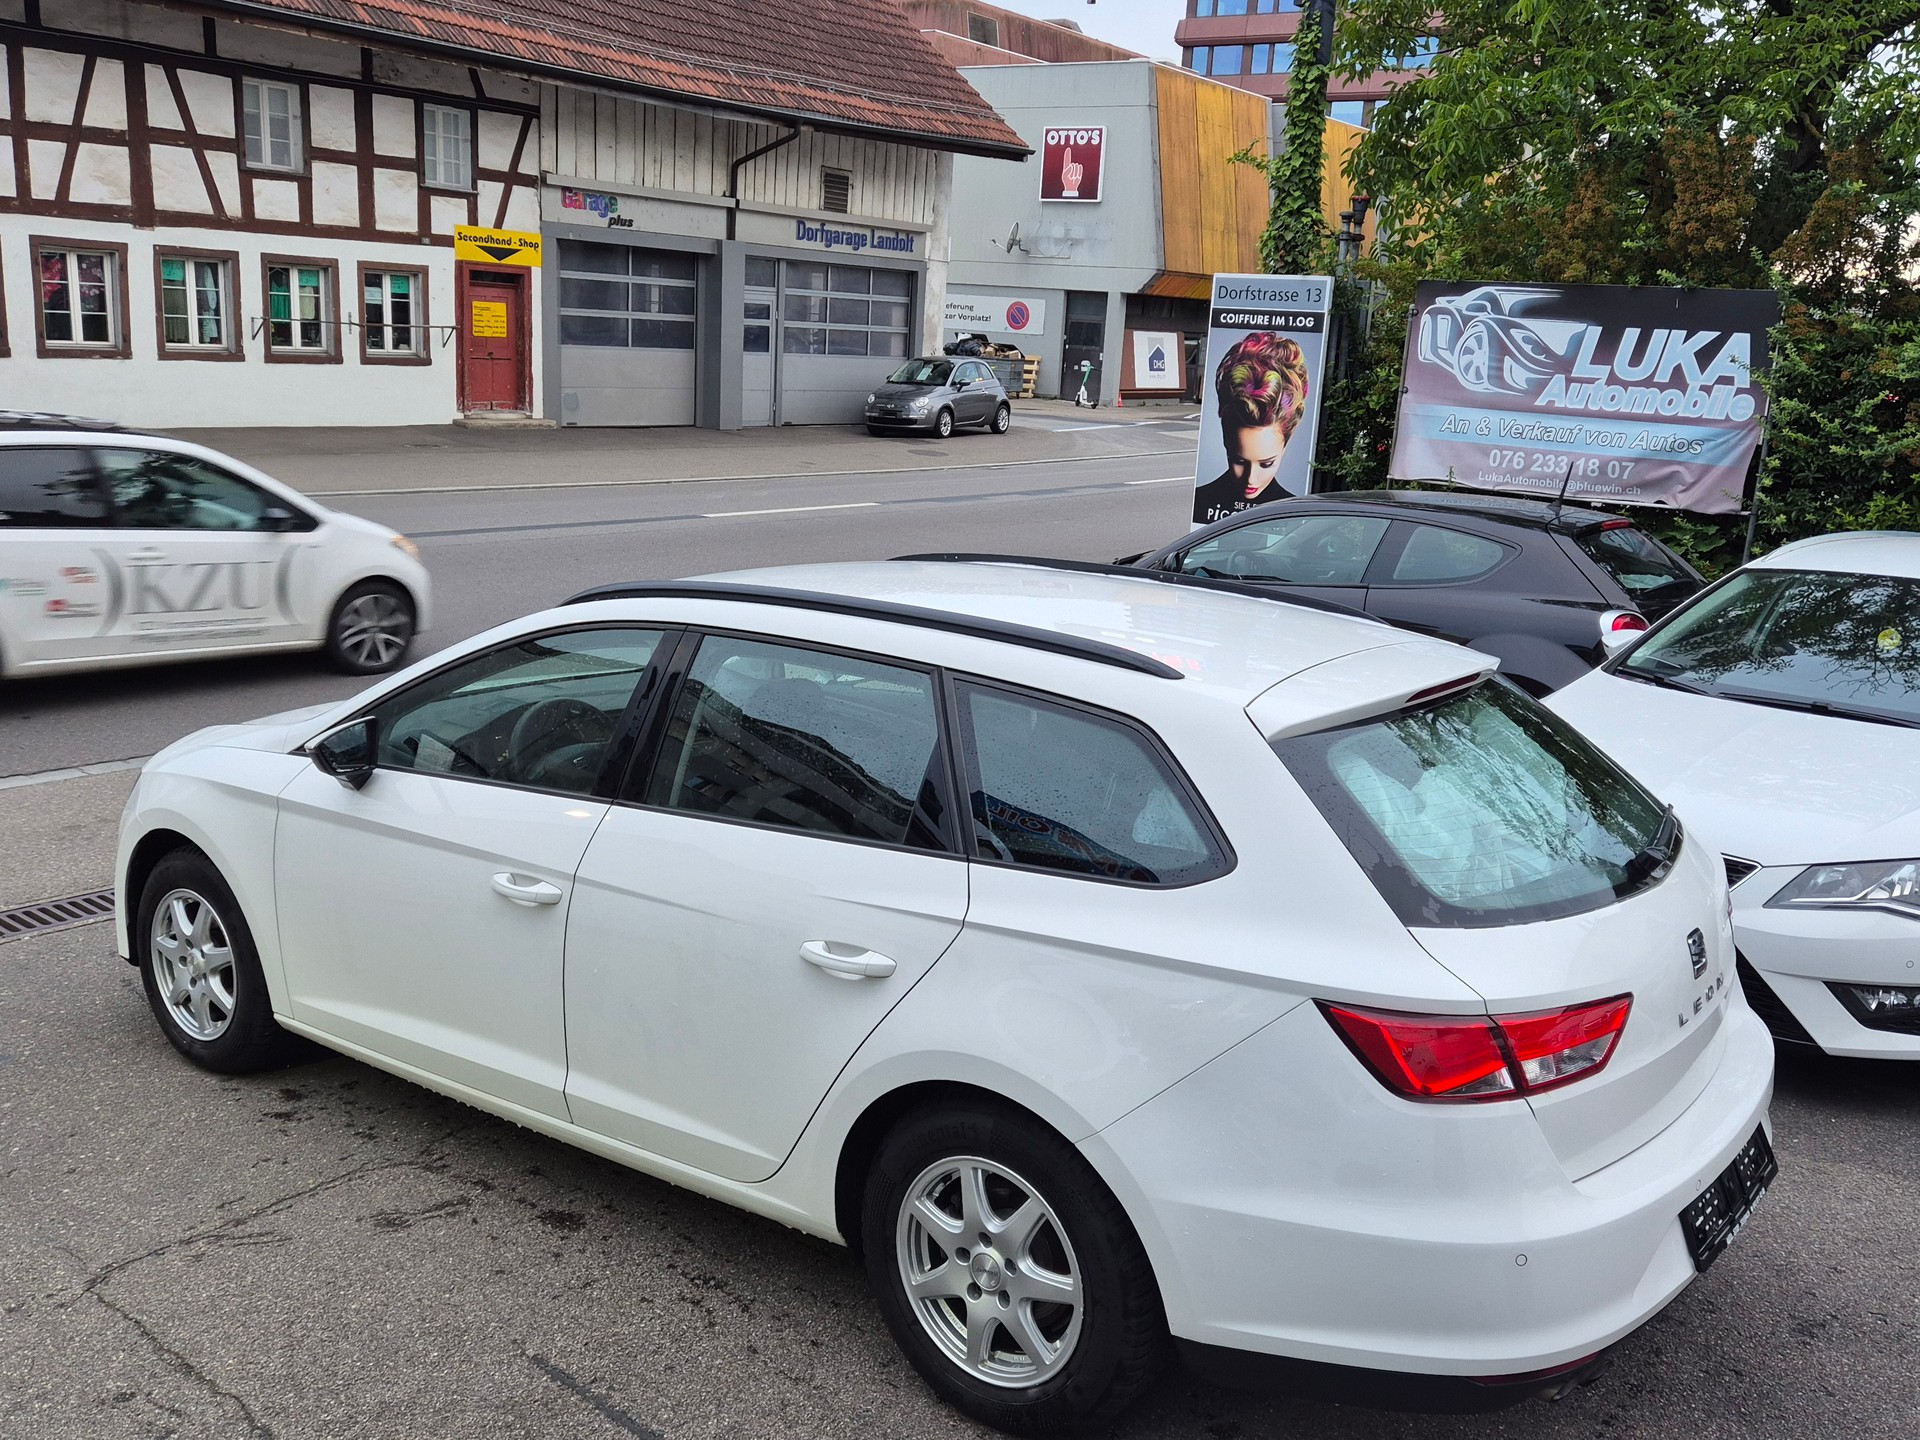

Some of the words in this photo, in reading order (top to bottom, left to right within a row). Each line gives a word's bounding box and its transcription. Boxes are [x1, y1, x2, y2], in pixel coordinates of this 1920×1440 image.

[1046, 129, 1100, 146] OTTO'S
[561, 186, 618, 218] Garage
[607, 214, 634, 228] plus
[457, 231, 512, 246] Secondhand
[518, 238, 540, 251] Shop
[796, 220, 867, 251] Dorfgarage
[870, 228, 914, 252] Landolt
[1218, 285, 1299, 302] Dorfstrasse
[1305, 287, 1322, 303] 13
[957, 313, 992, 322] Vorplatz!
[1220, 313, 1270, 326] COIFFURE
[1271, 315, 1285, 326] IM
[1288, 316, 1315, 328] 1.OG
[1153, 359, 1165, 369] DHG
[1570, 325, 1751, 388] LUKA
[1534, 373, 1756, 422] Automobile
[1439, 414, 1471, 434] An
[1475, 416, 1492, 437] &
[1499, 418, 1584, 444] Verkauf
[1585, 429, 1628, 449] von
[1629, 430, 1705, 456] Autos
[1489, 449, 1526, 470] 076
[1530, 453, 1568, 474] 233
[1576, 457, 1600, 477] 18
[1607, 460, 1636, 480] 07
[1478, 471, 1641, 495] LukaAutomobile@bluewin.ch
[1233, 501, 1245, 510] SIE
[1678, 972, 1723, 1028] LEON
